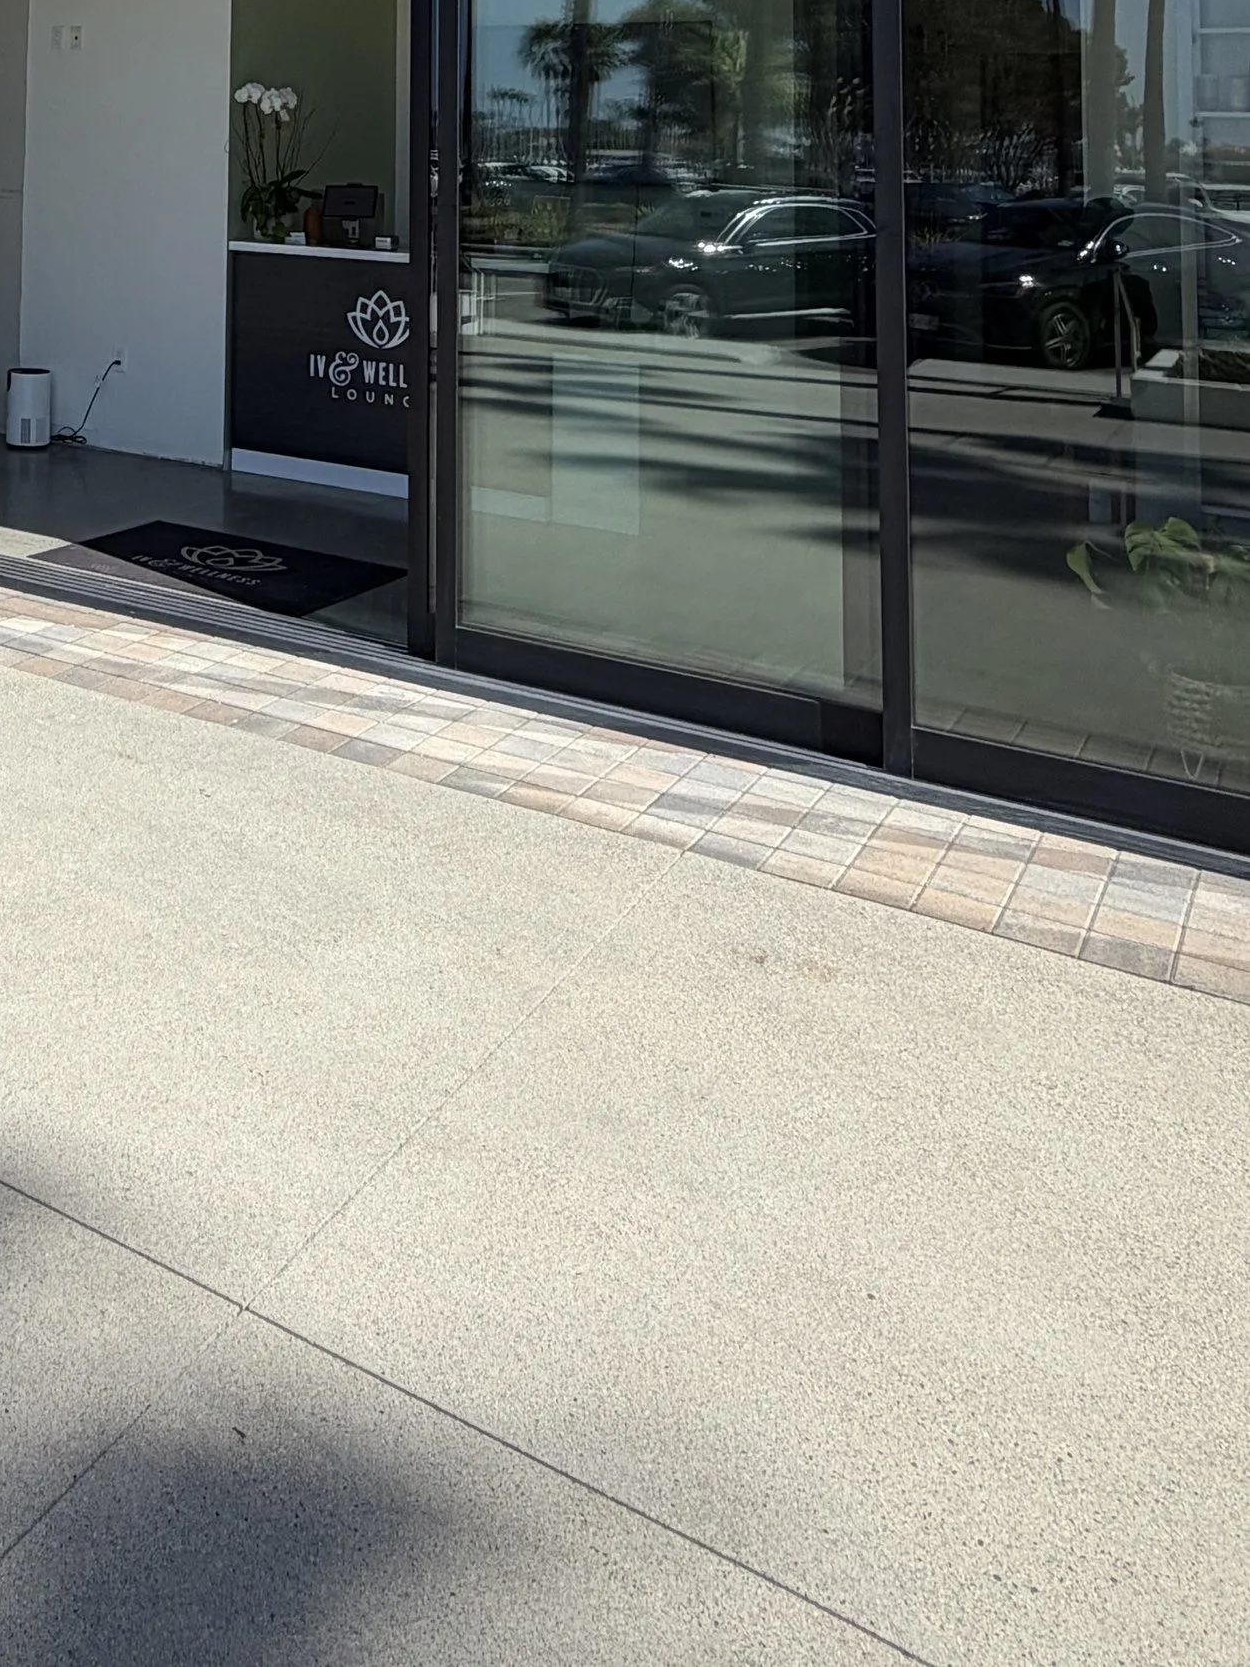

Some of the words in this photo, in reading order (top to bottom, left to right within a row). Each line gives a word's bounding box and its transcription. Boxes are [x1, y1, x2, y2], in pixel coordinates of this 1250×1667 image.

[310, 354, 326, 378] IV
[329, 351, 360, 386] &
[178, 565, 261, 586] WELLNESS
